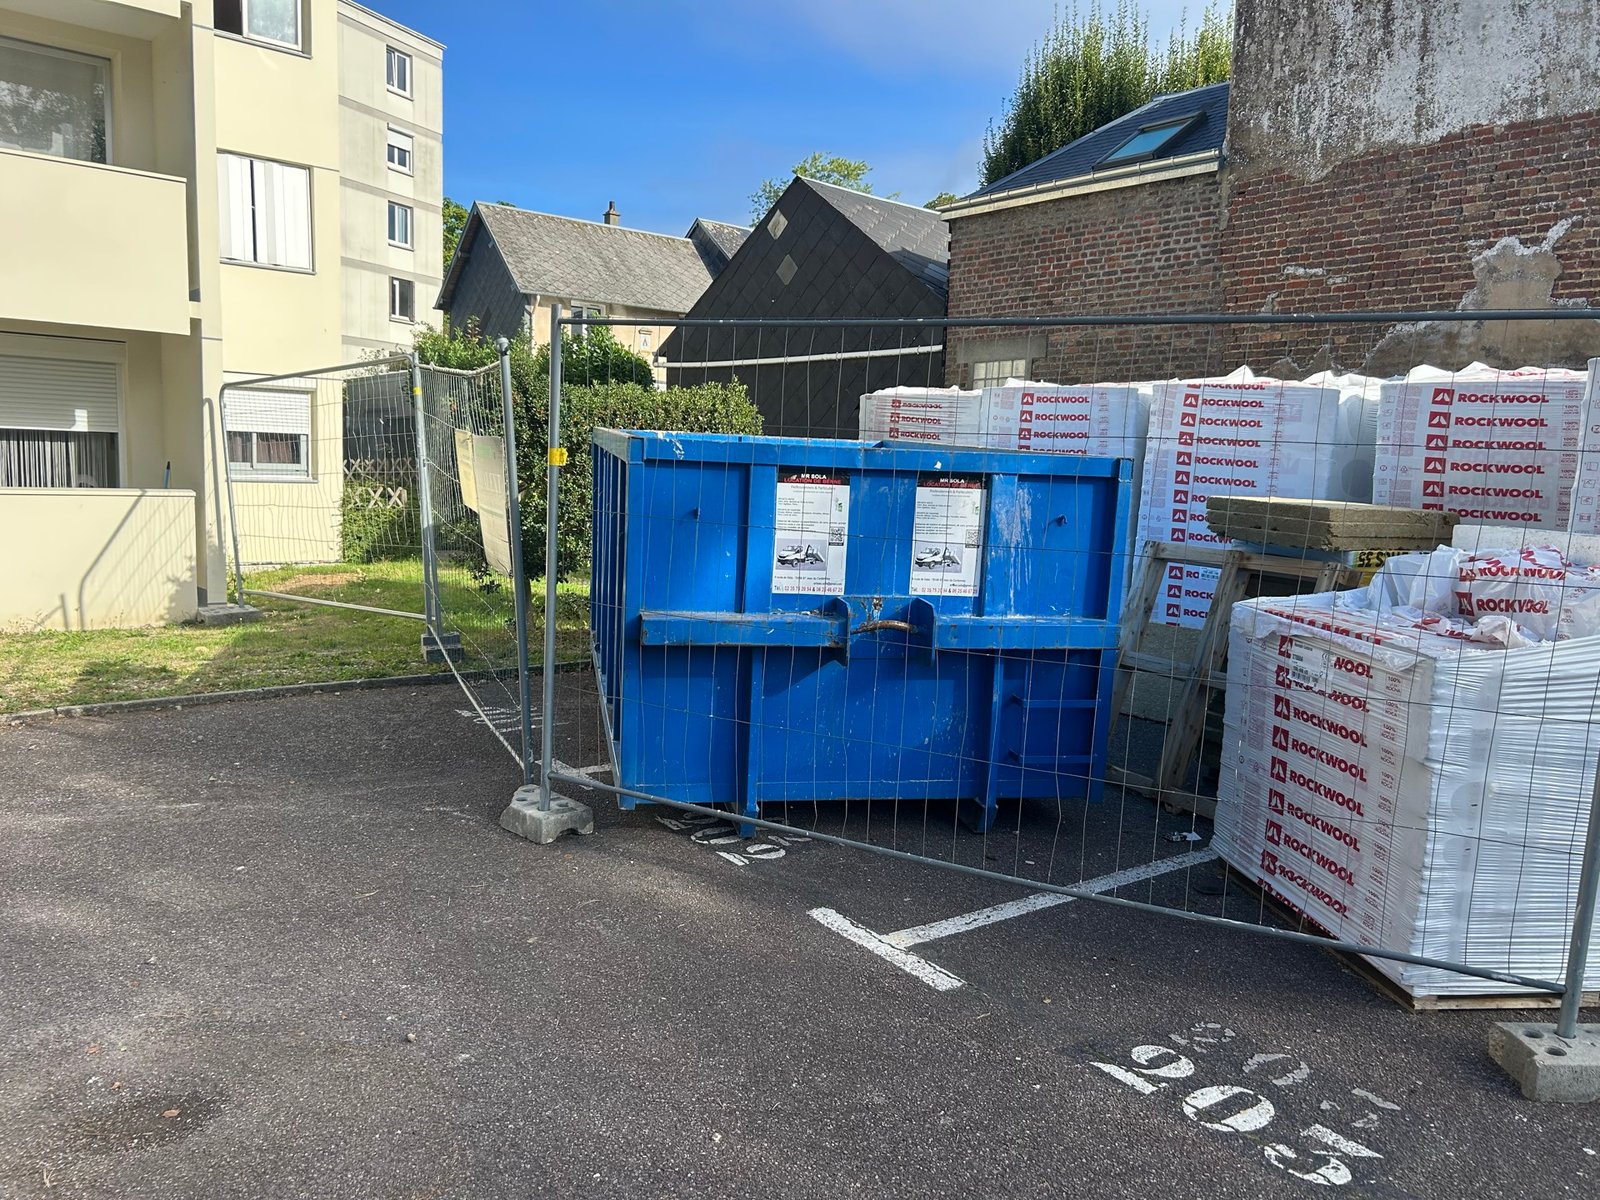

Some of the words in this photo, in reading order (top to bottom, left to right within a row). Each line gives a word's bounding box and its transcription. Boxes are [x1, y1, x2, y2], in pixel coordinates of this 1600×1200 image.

[1036, 395, 1090, 404] ROCKWOOL
[1201, 398, 1264, 408] ROCKWOOL
[1458, 393, 1549, 403] ROCKWOOL
[901, 415, 941, 425] ROCKWOOL
[1034, 413, 1090, 421] ROCKWOOL
[1199, 417, 1263, 428] ROCKWOOL
[1454, 416, 1548, 427] ROCKWOOL
[900, 431, 941, 440] ROCKWOOL
[1033, 431, 1089, 439] ROCKWOOL
[1196, 436, 1261, 447] ROCKWOOL
[1452, 439, 1546, 450] ROCKWOOL
[1194, 456, 1258, 468] ROCKWOOL
[1450, 462, 1545, 474] ROCKWOOL
[1193, 475, 1257, 488] ROCKWOOL
[1448, 485, 1543, 498] ROCKWOOL
[1388, 675, 1402, 683] 100%
[1386, 701, 1399, 709] 100%
[1293, 706, 1367, 748] ROCKWOOL
[1383, 723, 1396, 732] 100%
[1291, 737, 1367, 783] ROCKWOOL
[1381, 771, 1394, 780] 100%
[1289, 769, 1364, 817] ROCKWOOL
[1287, 801, 1360, 852] ROCKWOOL
[1283, 833, 1354, 887] ROCKWOOL
[1088, 1045, 1384, 1186] 203
